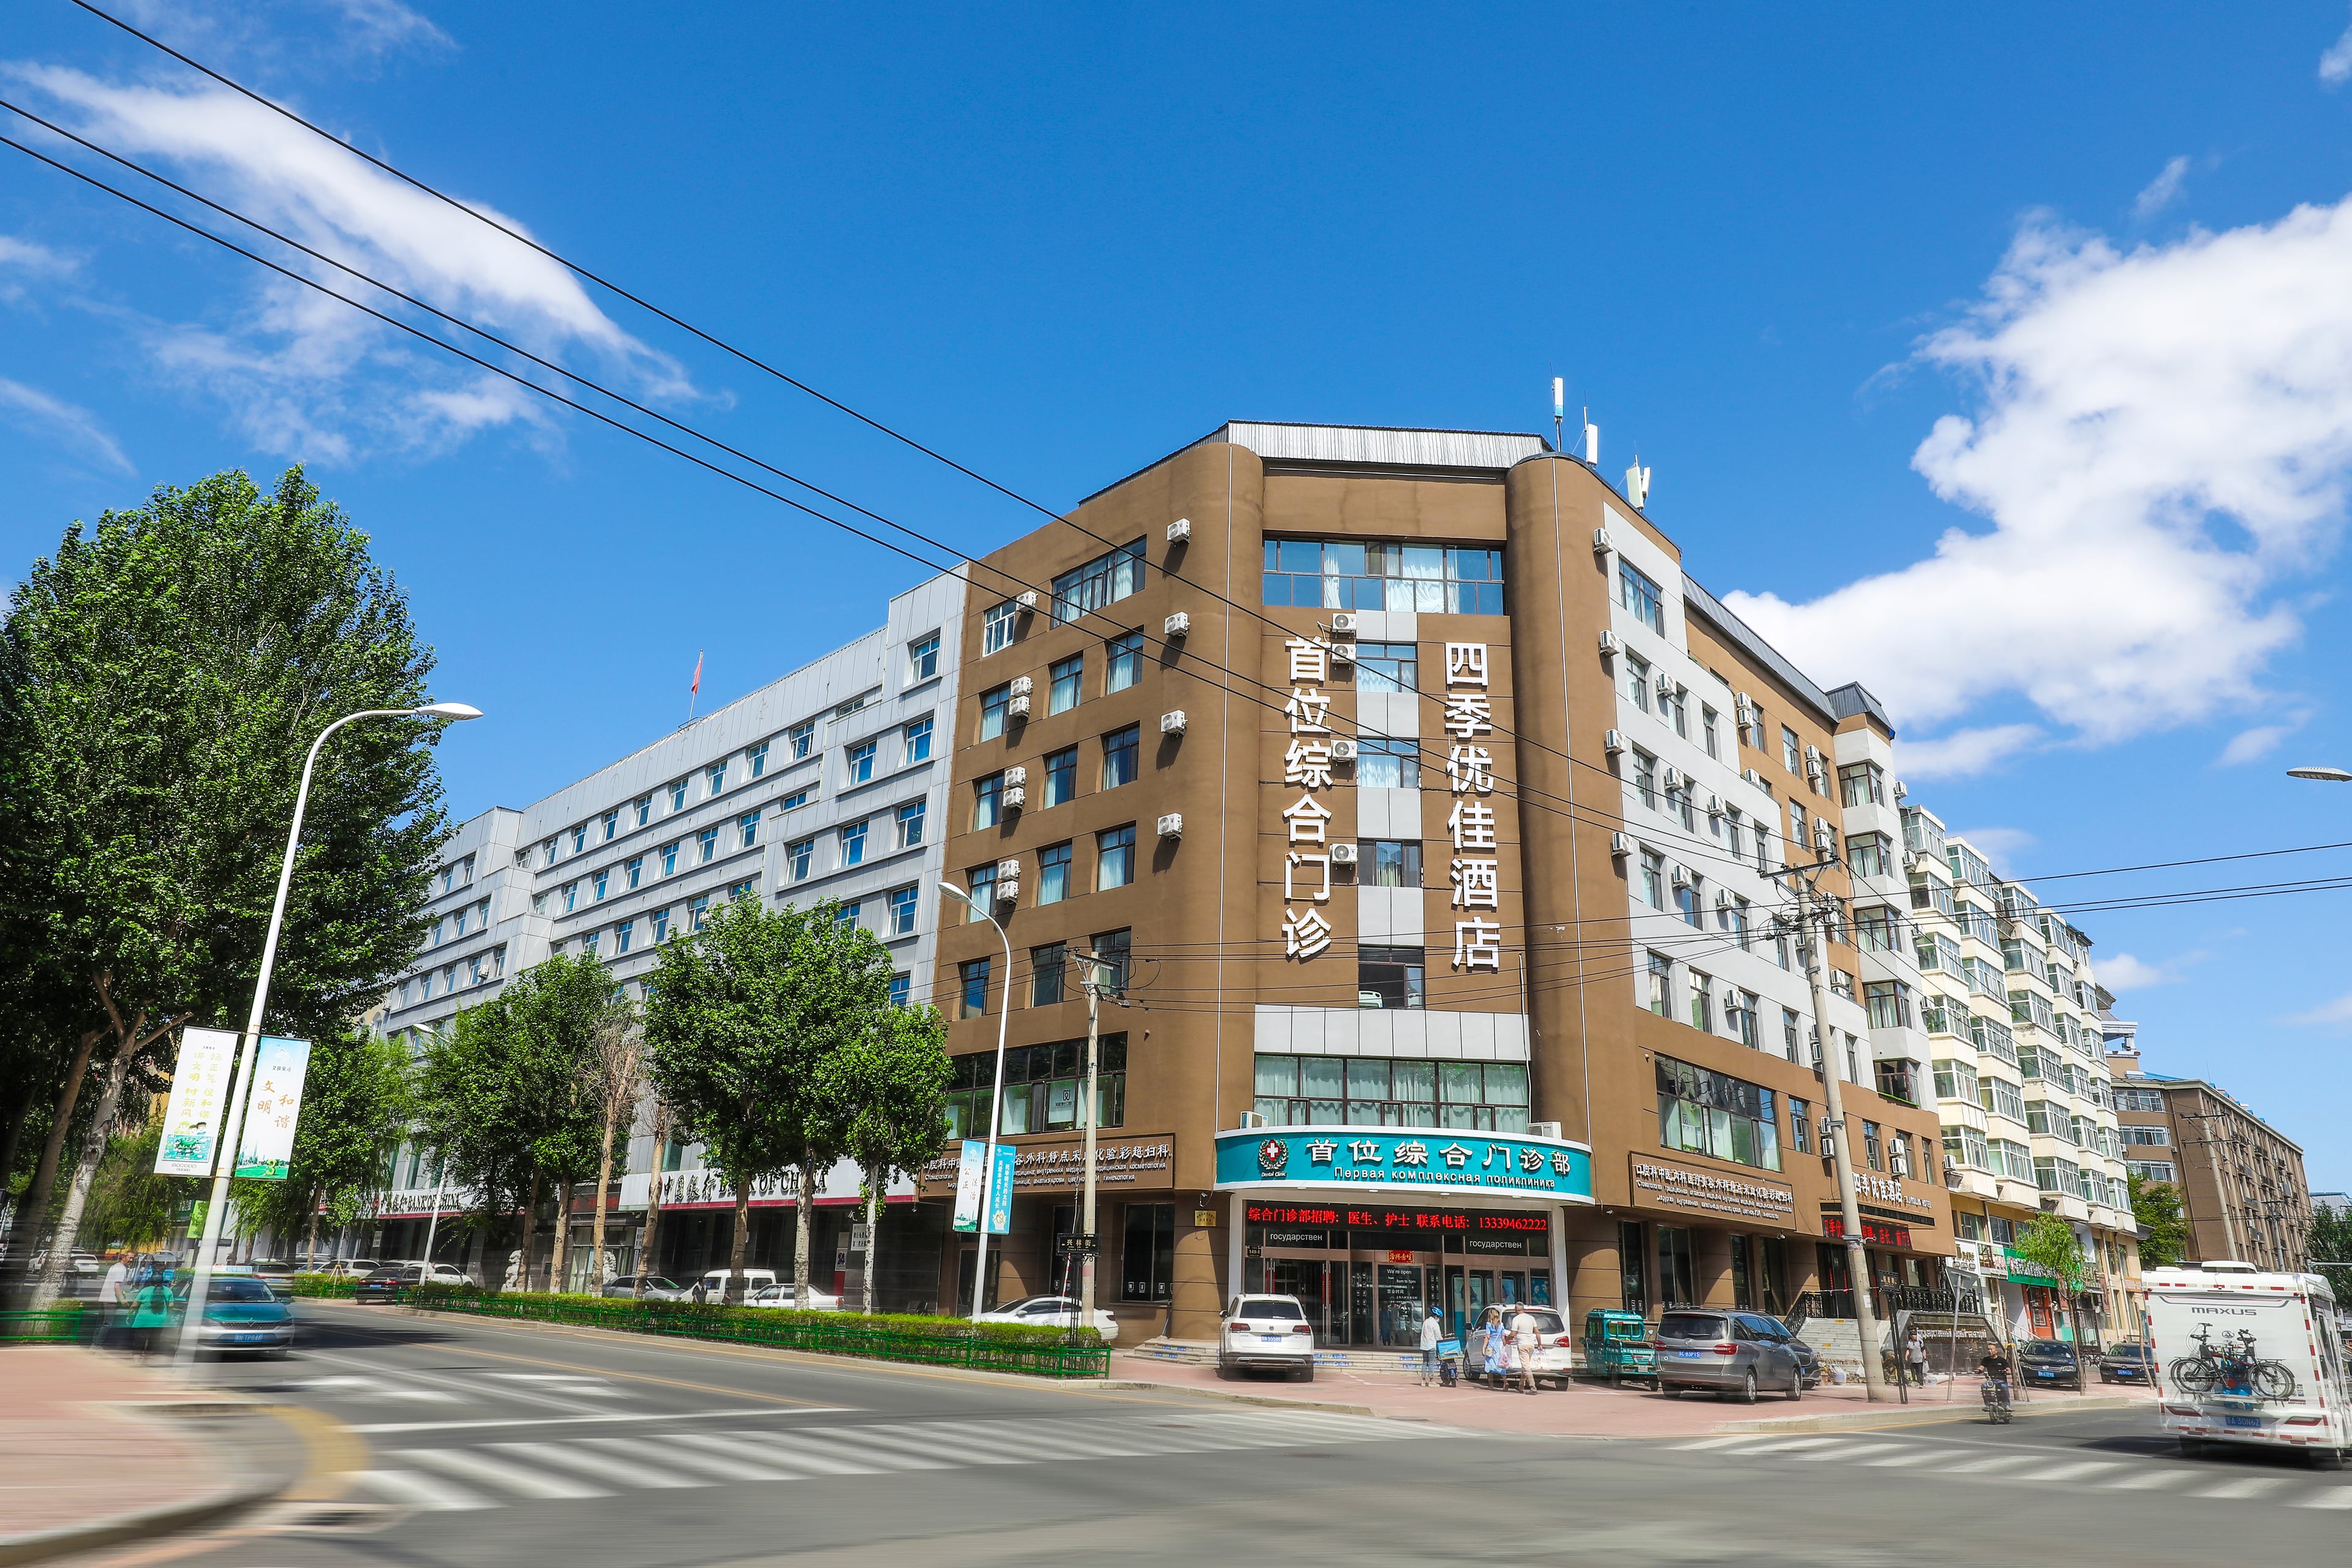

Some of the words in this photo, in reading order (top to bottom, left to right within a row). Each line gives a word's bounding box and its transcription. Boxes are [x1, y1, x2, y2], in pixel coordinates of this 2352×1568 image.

[1282, 636, 1333, 959] 首位综合门诊
[1444, 642, 1501, 969] 四季优佳酒店
[257, 1080, 275, 1114] 文明
[274, 1094, 294, 1129] 和谐
[1306, 1138, 1571, 1175] 首位综合门诊部
[781, 1170, 827, 1191] CHA
[962, 1167, 971, 1189] 公正
[970, 1177, 978, 1200] 法治
[1334, 1167, 1385, 1180] Первая
[1391, 1170, 1480, 1183] комплексная
[1487, 1174, 1555, 1188] поликлиника
[1852, 1172, 1903, 1203] 四季优佳酒店
[408, 1194, 428, 1208] BANK
[1479, 1216, 1547, 1231] 13339462222
[1270, 1232, 1322, 1242] государствен
[1469, 1240, 1522, 1250] государствен
[2192, 1307, 2257, 1316] MAXUS
